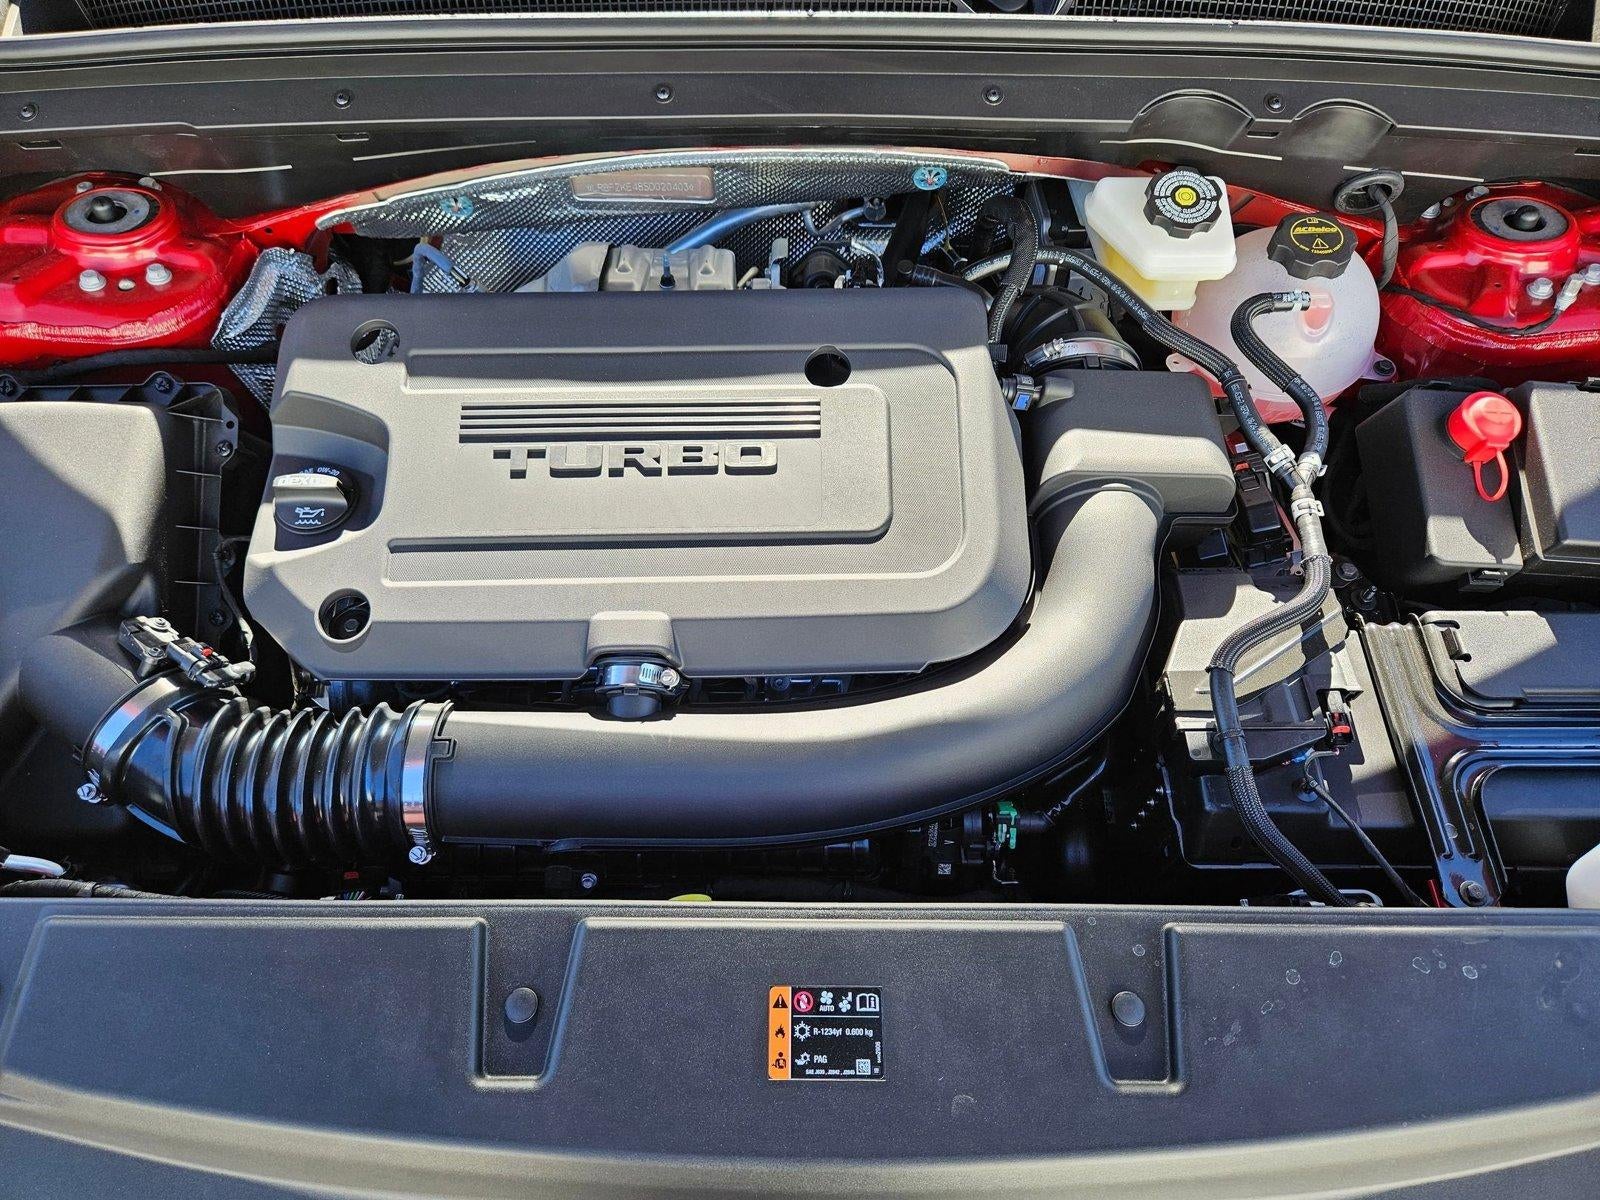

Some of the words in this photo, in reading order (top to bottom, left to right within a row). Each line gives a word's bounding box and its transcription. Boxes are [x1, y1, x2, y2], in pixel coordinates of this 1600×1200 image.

[1293, 226, 1338, 234] ACDelco
[492, 442, 778, 479] TURBO
[819, 1004, 835, 1012] AUTO
[813, 1028, 842, 1037] R-1234yf
[845, 1028, 864, 1036] 0.600
[864, 1028, 874, 1038] kg
[813, 1055, 828, 1064] PAG
